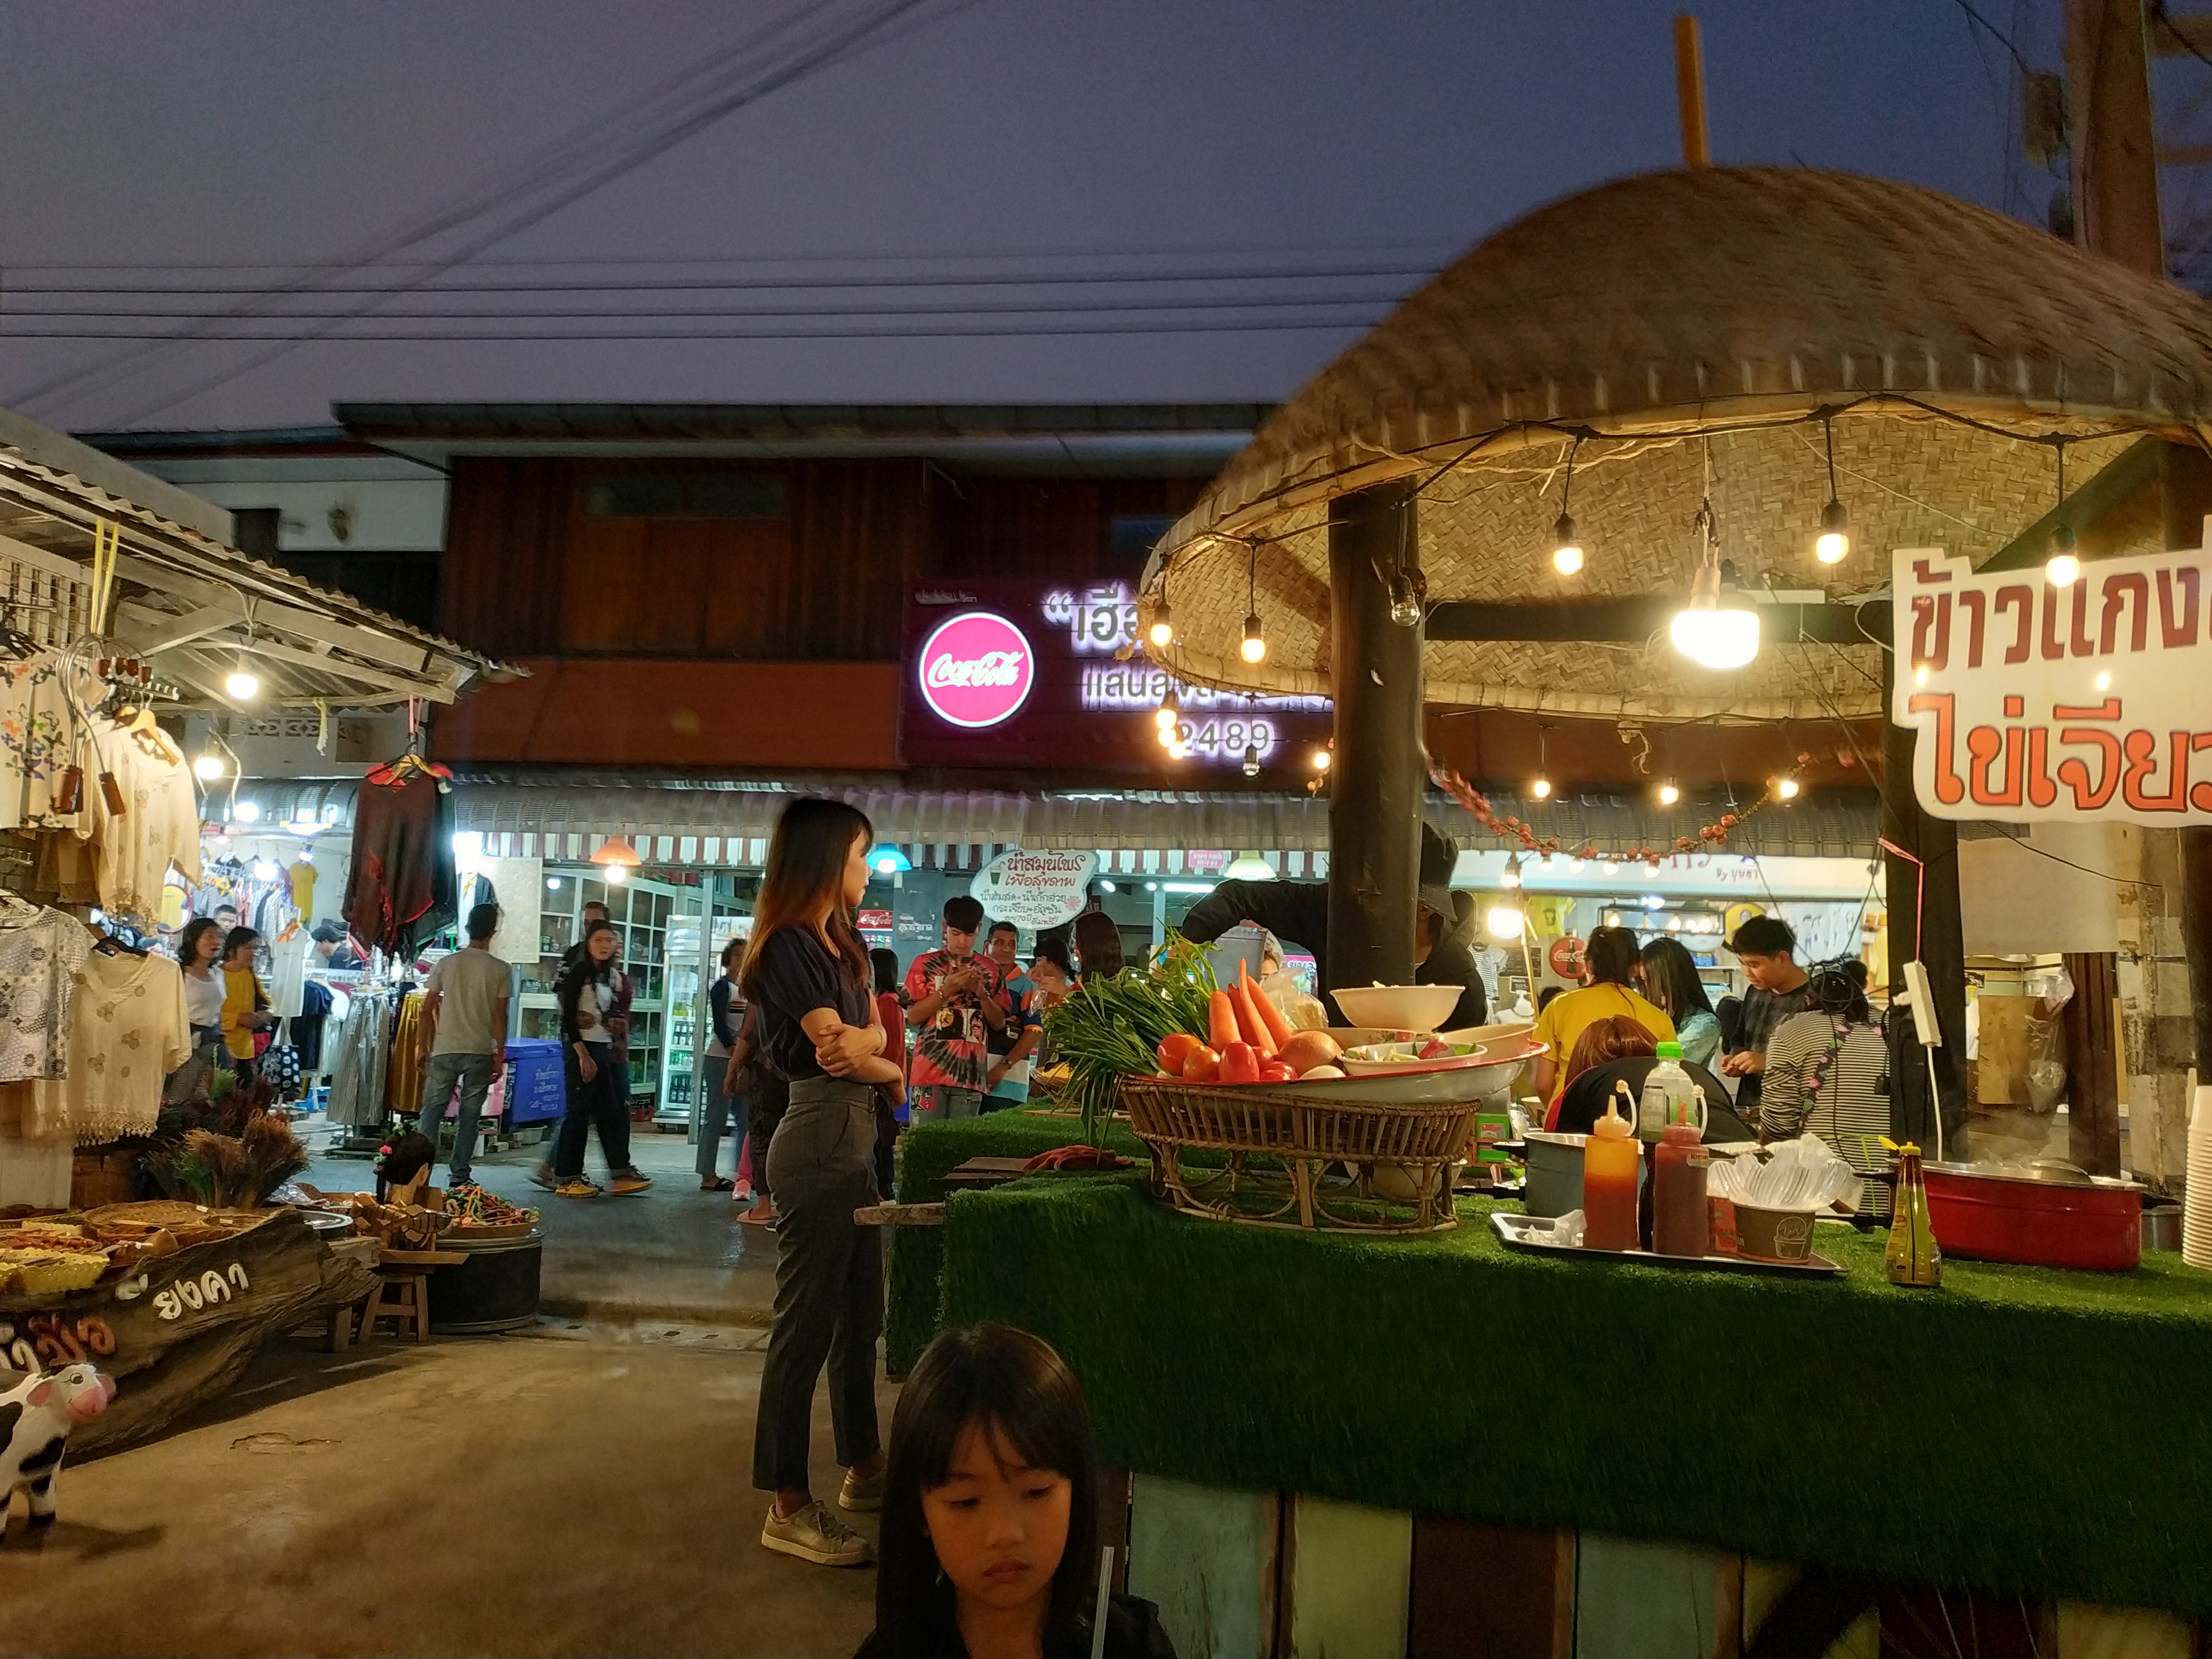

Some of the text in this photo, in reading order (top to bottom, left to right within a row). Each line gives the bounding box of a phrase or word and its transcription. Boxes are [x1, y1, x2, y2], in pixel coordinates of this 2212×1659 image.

[1911, 560, 2212, 671] ข้าวแกง
[928, 651, 1024, 688] Coca-Cola
[1007, 851, 1087, 875] น้ำสมุนไพร
[1005, 871, 1076, 890] เพื่อสุขภาพ
